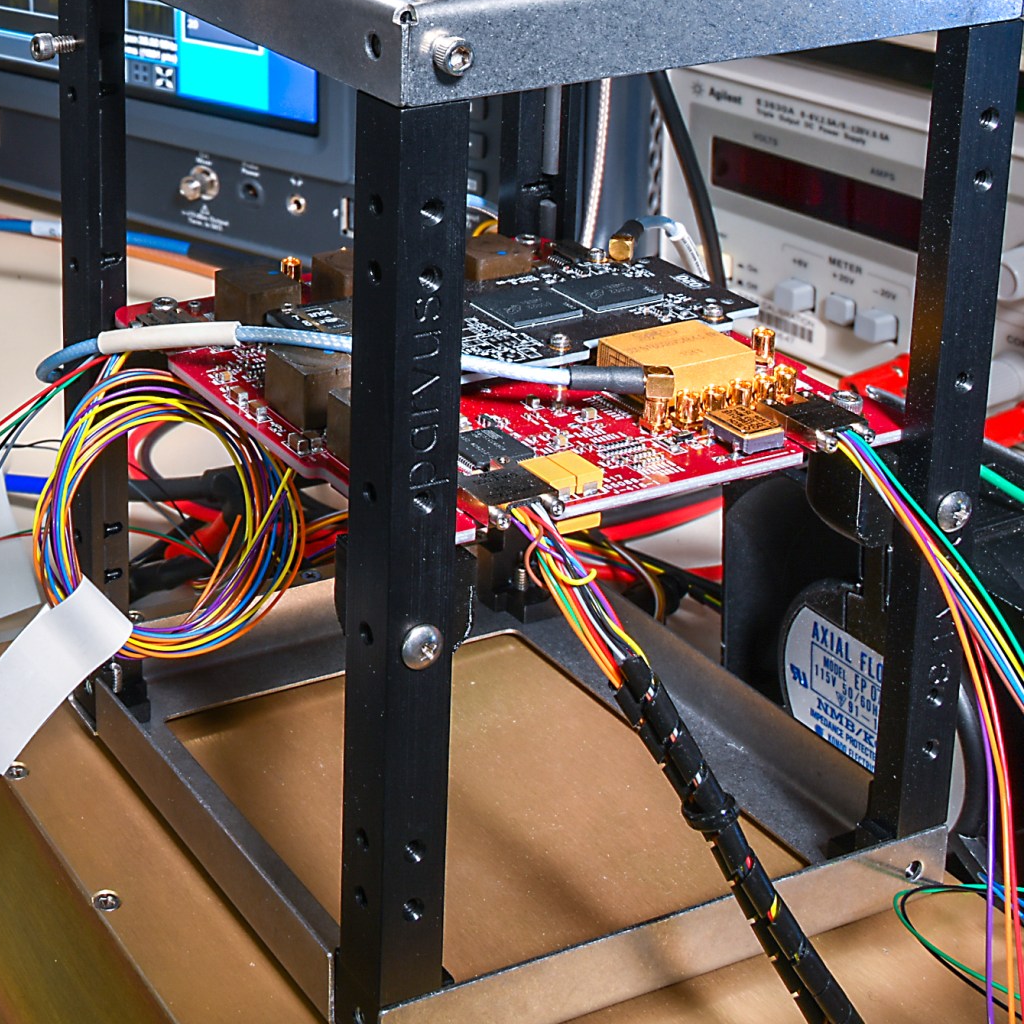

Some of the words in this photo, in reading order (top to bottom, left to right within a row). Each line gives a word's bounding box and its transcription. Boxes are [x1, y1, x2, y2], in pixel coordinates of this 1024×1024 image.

[708, 86, 743, 106] Agilent
[756, 107, 775, 120] Triple
[778, 113, 801, 127] Output
[804, 120, 815, 130] DC
[818, 125, 839, 138] Power
[843, 131, 867, 146] Supply
[752, 132, 779, 147] VOLTS
[869, 167, 896, 182] AMPS
[828, 256, 863, 275] METER
[811, 621, 852, 664] AXIAL
[814, 664, 837, 688] 115V
[823, 655, 847, 683] MODEL
[854, 674, 867, 693] EP
[810, 707, 845, 741] IMPEDANCE
